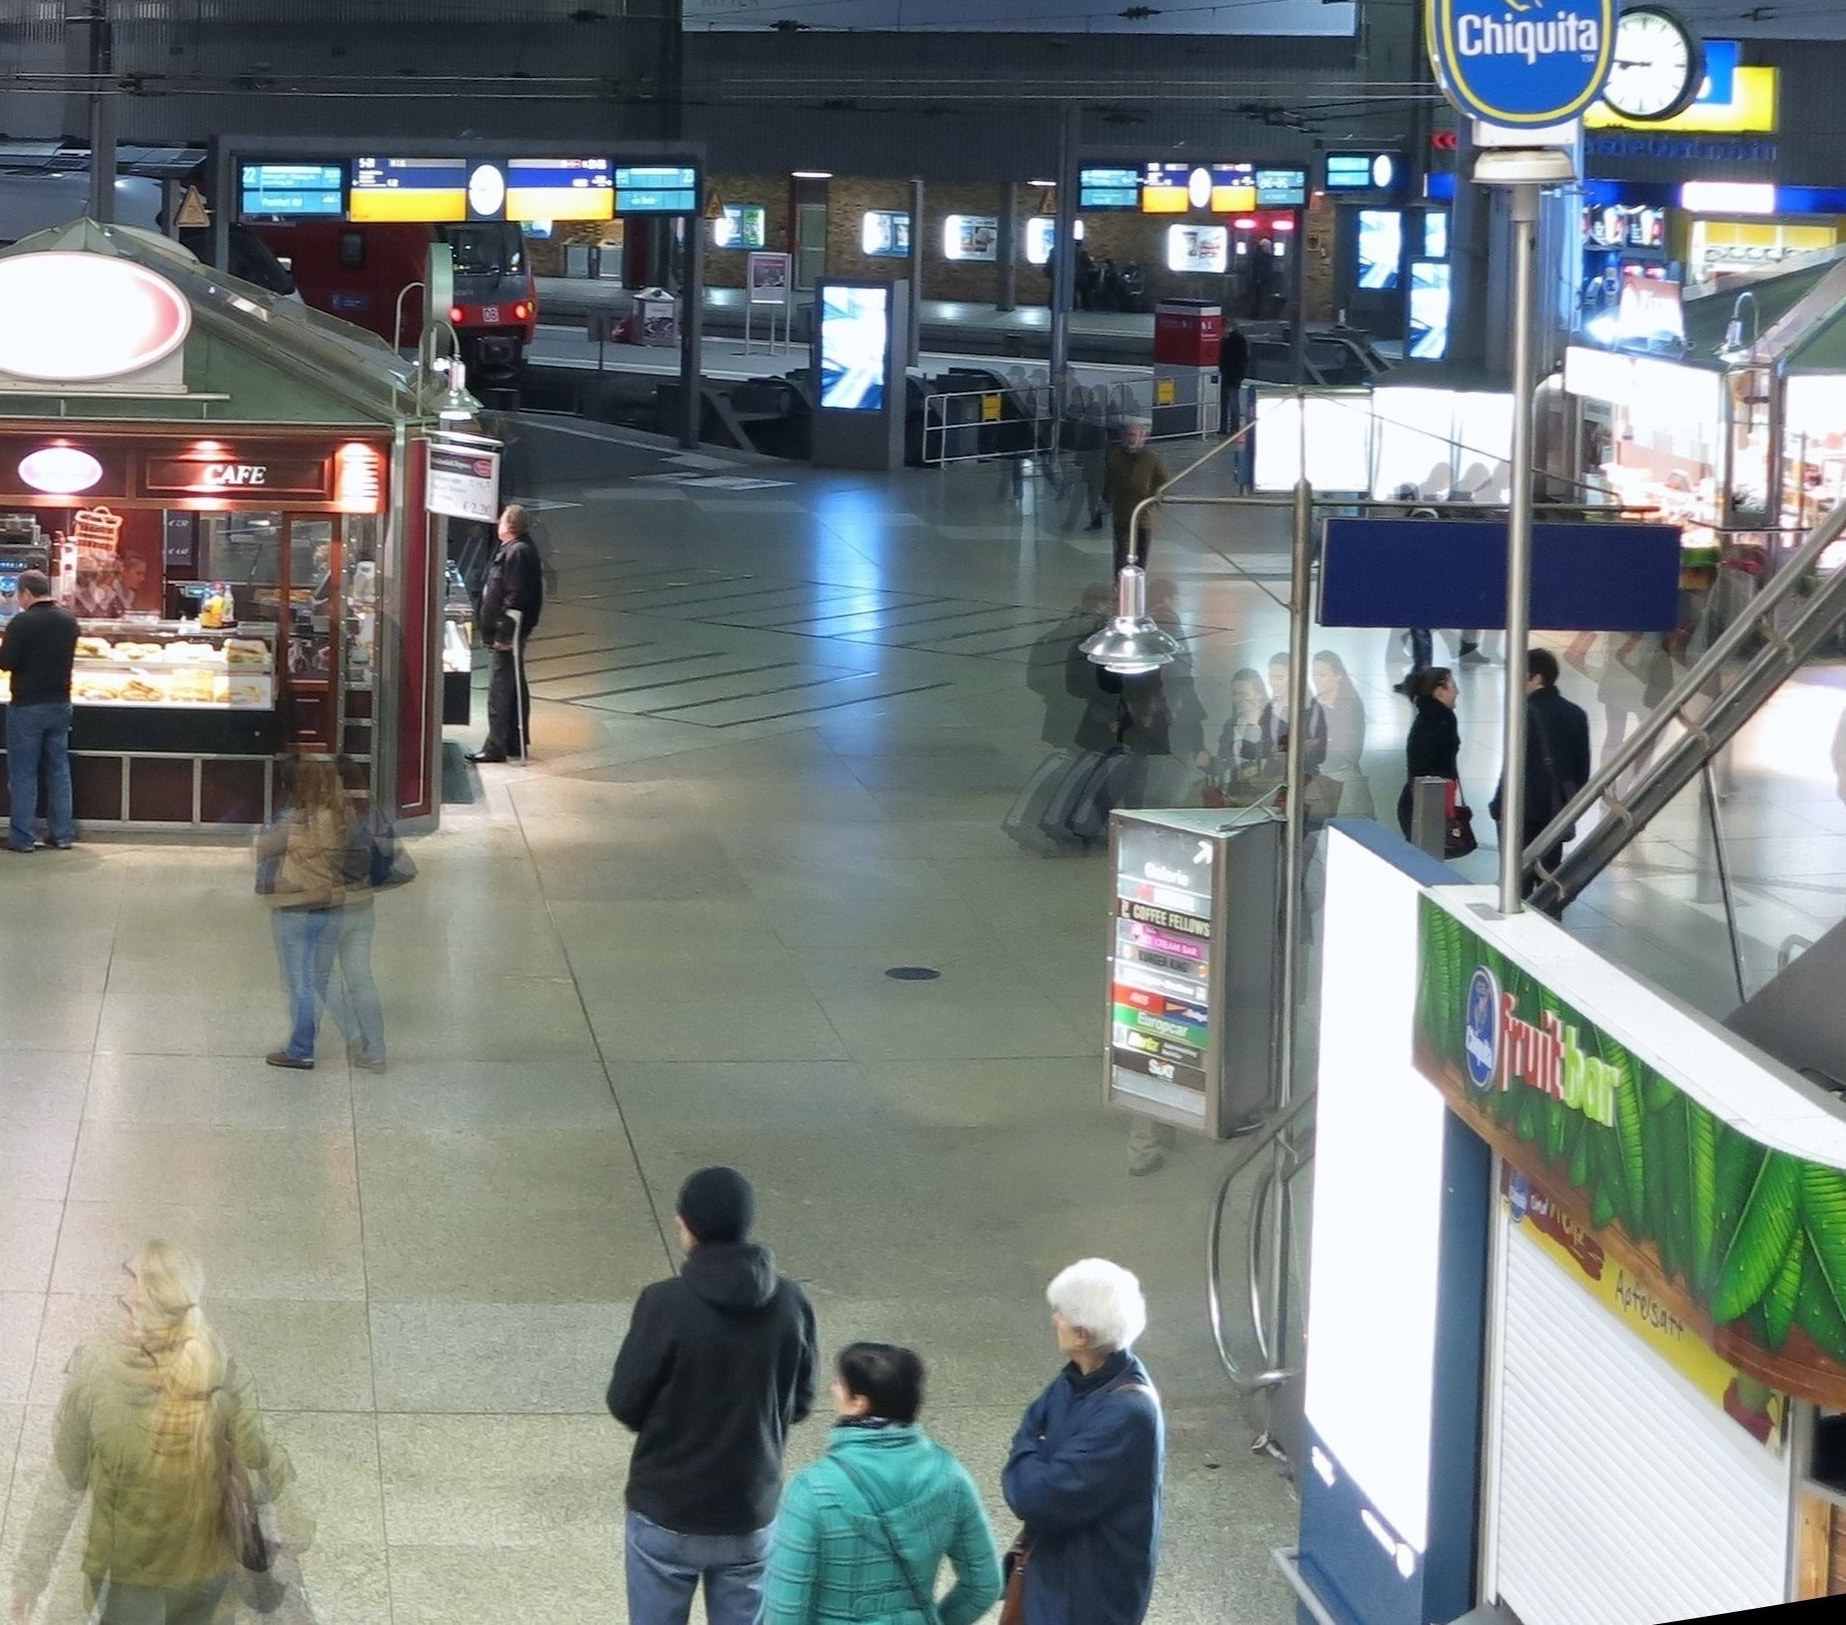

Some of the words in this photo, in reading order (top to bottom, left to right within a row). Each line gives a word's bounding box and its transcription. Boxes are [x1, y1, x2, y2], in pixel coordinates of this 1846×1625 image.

[1457, 10, 1599, 66] Chiquita
[483, 307, 499, 322] DB
[203, 464, 267, 486] CAFE
[1133, 904, 1167, 927] COFFEE
[1169, 911, 1211, 937] FELLOWS
[1497, 991, 1621, 1128] fruitbar
